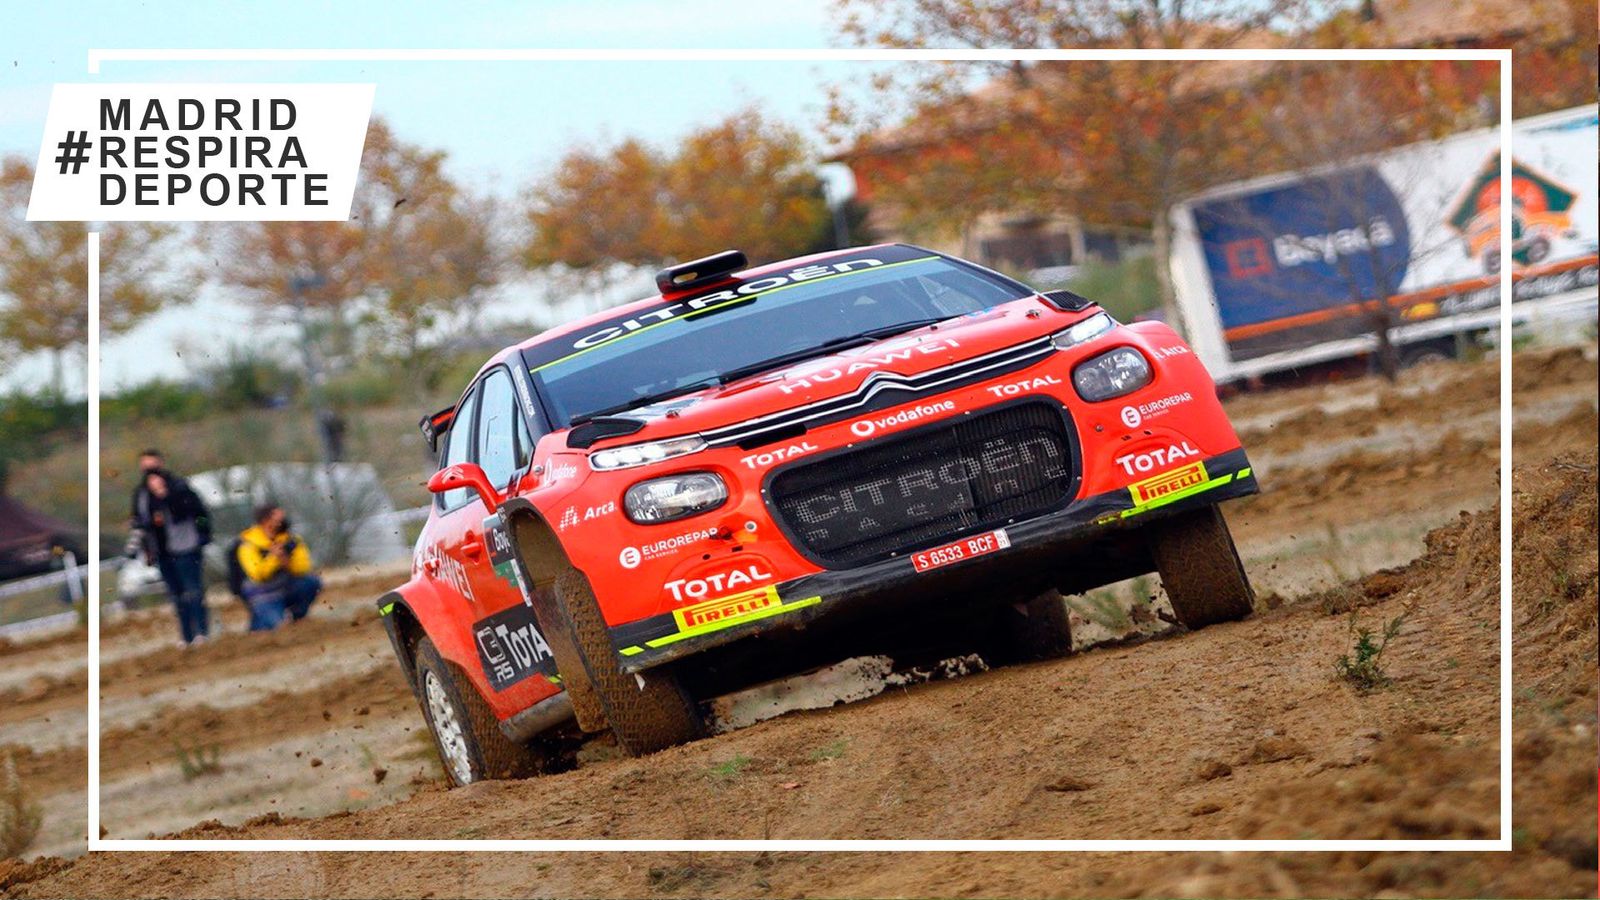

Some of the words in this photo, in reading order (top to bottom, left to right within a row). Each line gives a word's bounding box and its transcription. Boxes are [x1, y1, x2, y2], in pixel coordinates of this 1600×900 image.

[778, 338, 960, 394] HUAWEI
[987, 374, 1062, 398] TOTAL
[874, 400, 955, 429] vodafone
[1138, 392, 1193, 415] EUROREPAR
[740, 440, 818, 469] TOTAL
[1116, 441, 1199, 475] TOTAL
[1137, 466, 1203, 501] PIRELLI
[584, 500, 616, 521] Arca
[917, 555, 929, 568] S
[930, 545, 964, 565] 6533
[967, 535, 995, 554] BCF
[664, 566, 771, 601] TOTAL
[682, 592, 770, 627] PIRELLI
[495, 623, 553, 670] TOTA
